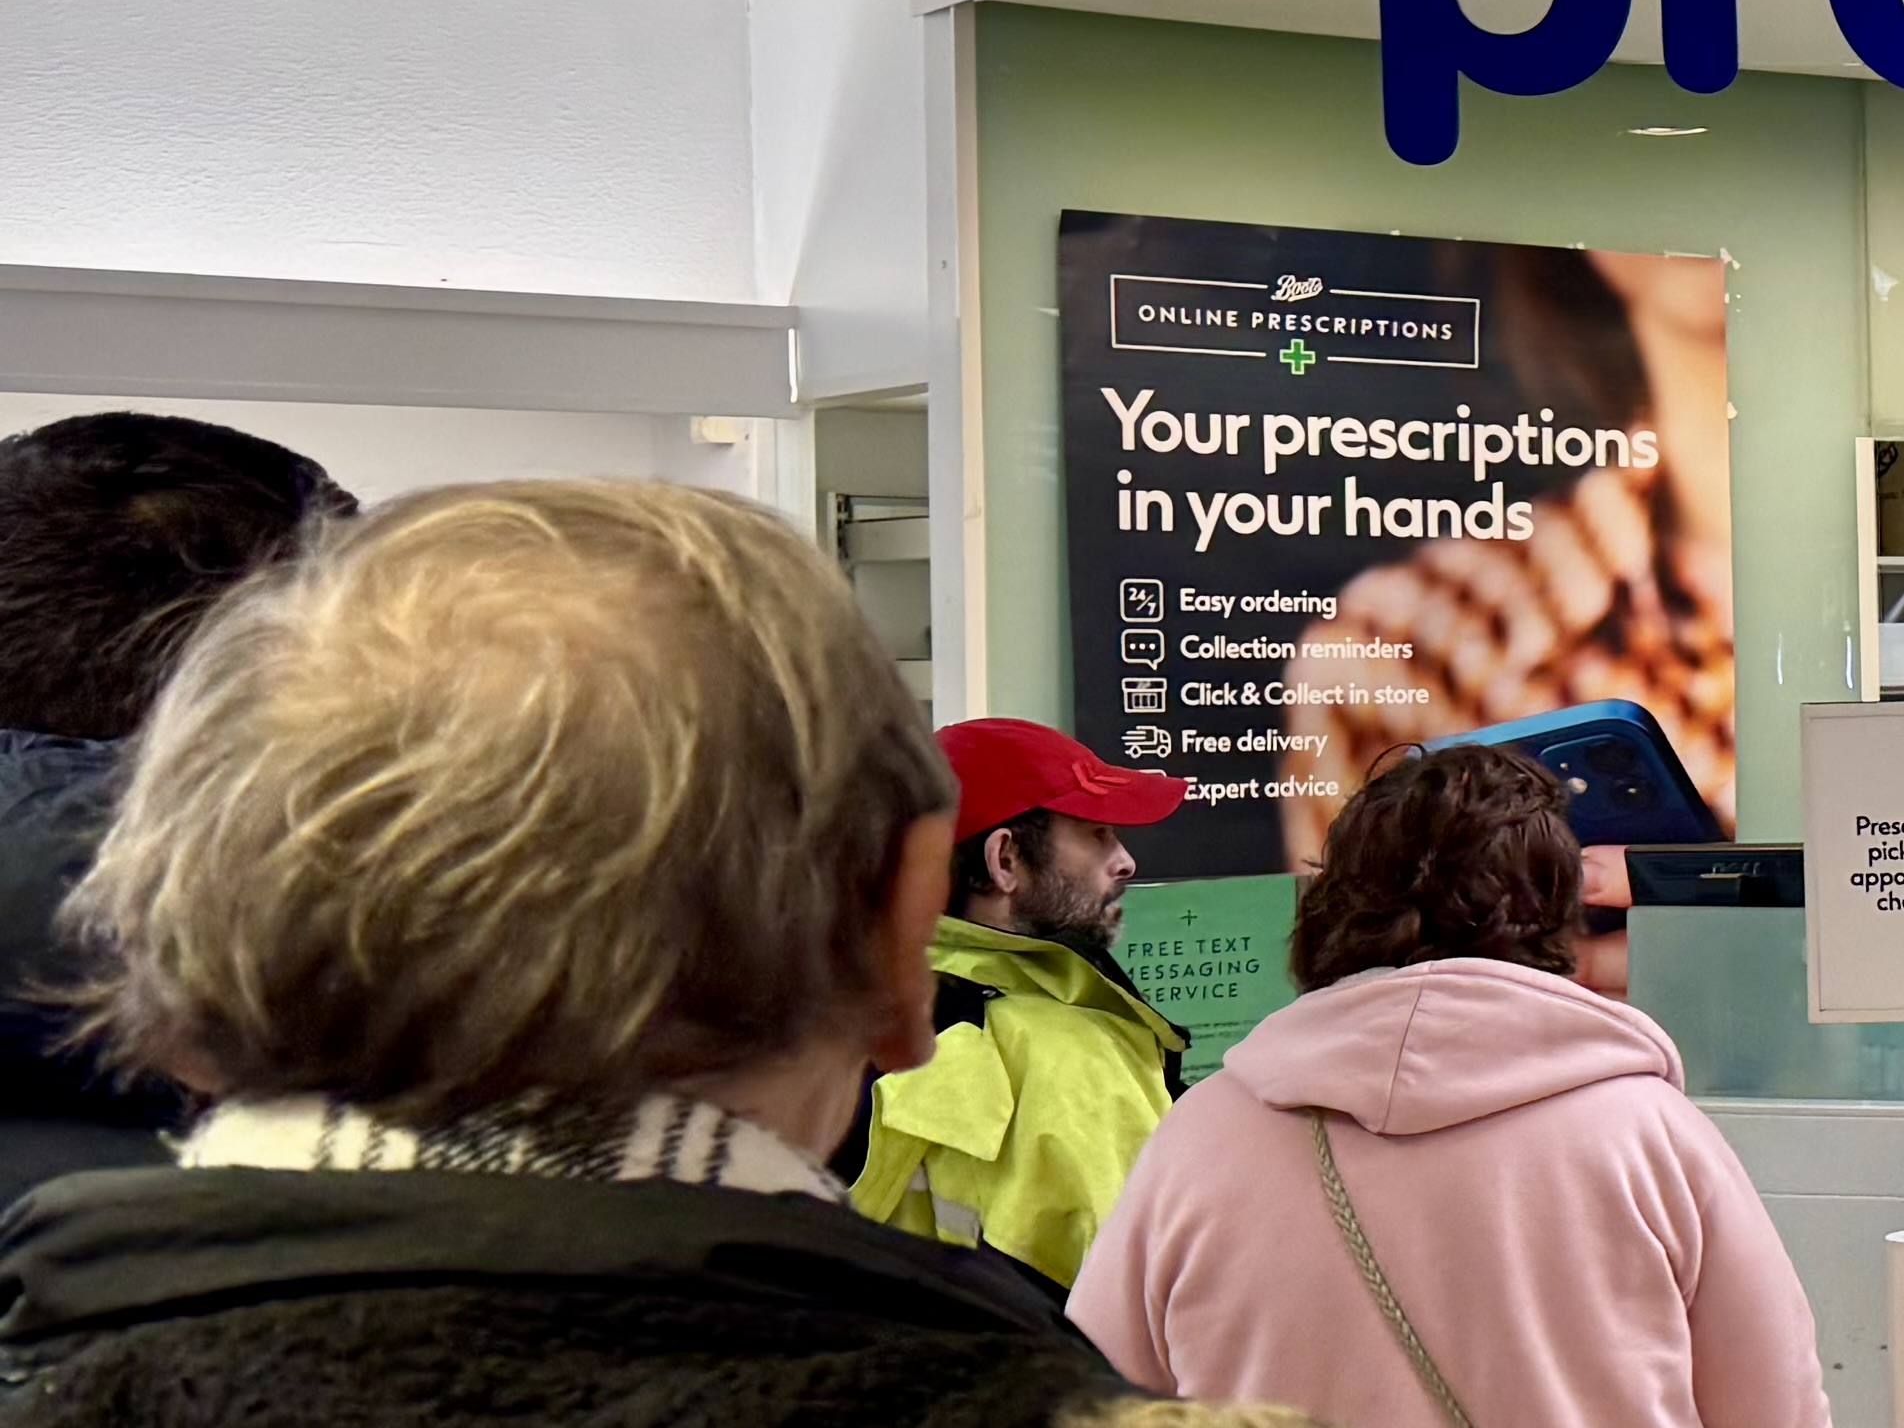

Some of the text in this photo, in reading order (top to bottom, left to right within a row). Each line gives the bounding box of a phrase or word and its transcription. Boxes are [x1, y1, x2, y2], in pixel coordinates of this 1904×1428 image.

[1271, 274, 1323, 301] Boots
[1138, 304, 1452, 341] ONLINE PRESCRIPTIONS
[1102, 388, 1659, 482] Your prescriptions
[1118, 470, 1533, 552] in your hands
[1180, 588, 1337, 618] Easy ordering
[1180, 636, 1412, 661] Collection reminders
[1181, 682, 1429, 706] Click & Collect in store
[1181, 728, 1328, 758] Free delivery
[1184, 776, 1338, 802] Expert advice
[1128, 937, 1251, 958] FREE TEXT
[1141, 983, 1238, 1002] SERVICE
